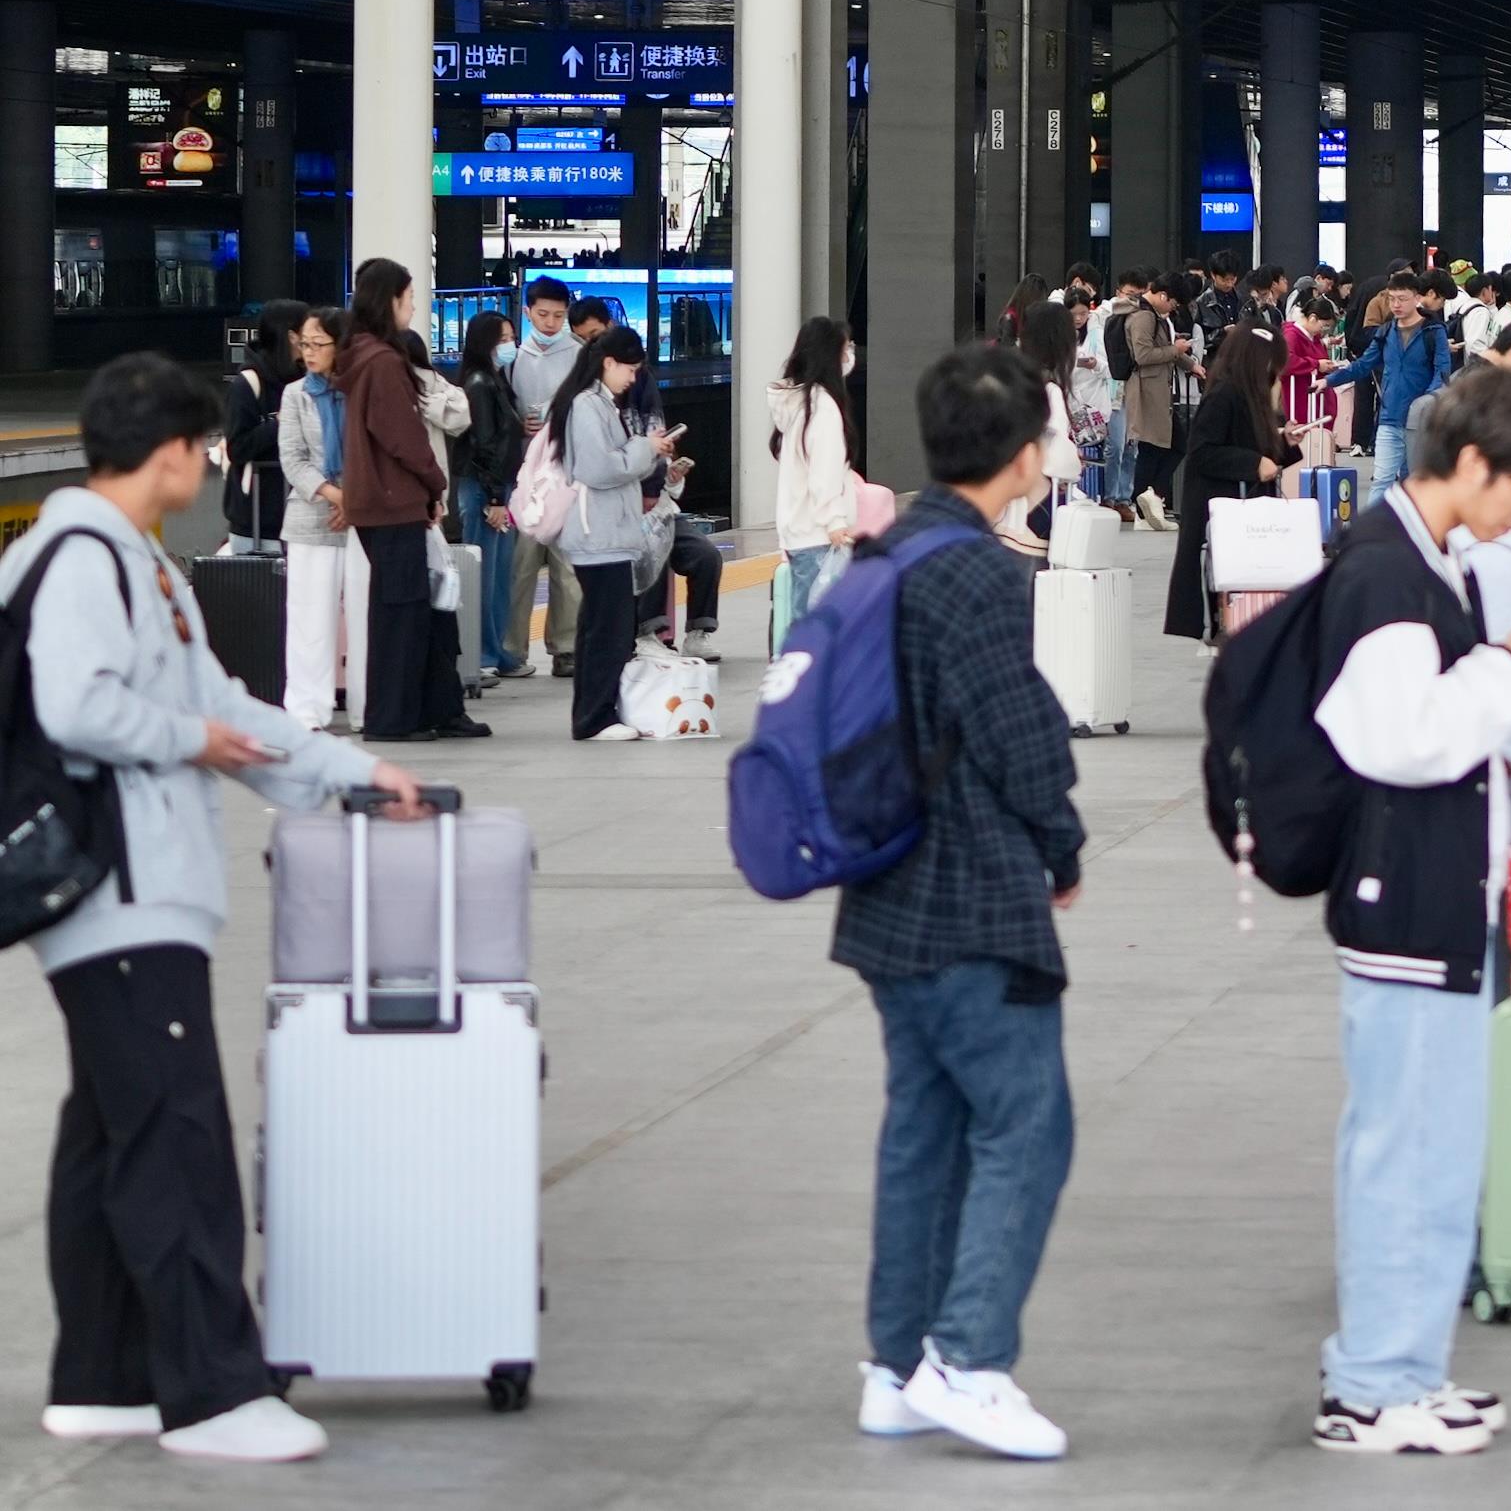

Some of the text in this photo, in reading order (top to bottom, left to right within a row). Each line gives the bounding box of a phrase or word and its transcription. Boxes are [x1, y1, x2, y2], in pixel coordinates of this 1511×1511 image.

[465, 44, 528, 67] 出站口
[640, 44, 726, 68] 便捷换乘
[465, 68, 486, 80] Exit
[640, 68, 686, 80] Transfer
[993, 110, 1003, 149] C276
[1049, 110, 1059, 149] C278
[432, 166, 450, 176] A4
[478, 165, 623, 183] 便捷换乘前行180米
